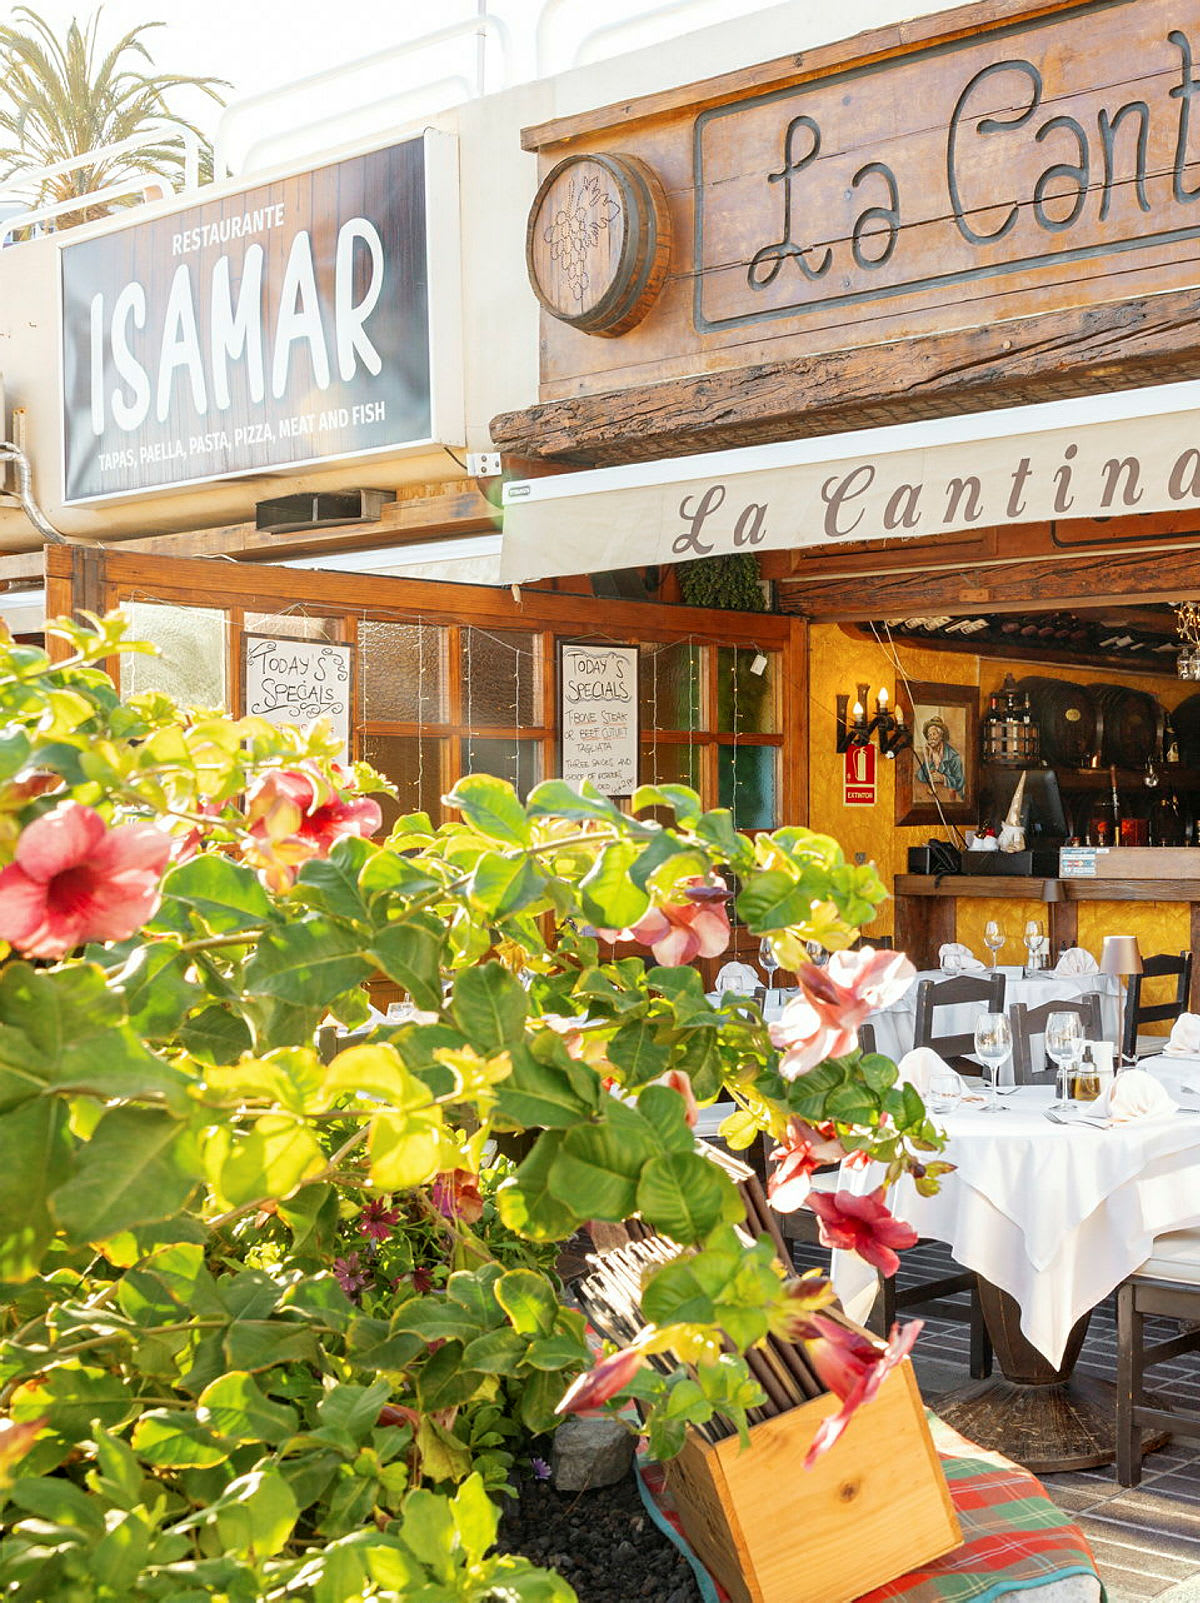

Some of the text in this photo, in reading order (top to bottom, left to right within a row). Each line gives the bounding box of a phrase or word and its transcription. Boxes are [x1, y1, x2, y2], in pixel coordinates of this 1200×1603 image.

[172, 203, 286, 256] RESTAURANTE
[746, 114, 900, 291] La
[90, 216, 386, 436] ISAMAR
[98, 401, 386, 471] TAPAS, PAELLA, PASTA, PIZZA, MEAT AND FISH
[672, 484, 769, 556] La
[568, 680, 629, 701] SPECIALS
